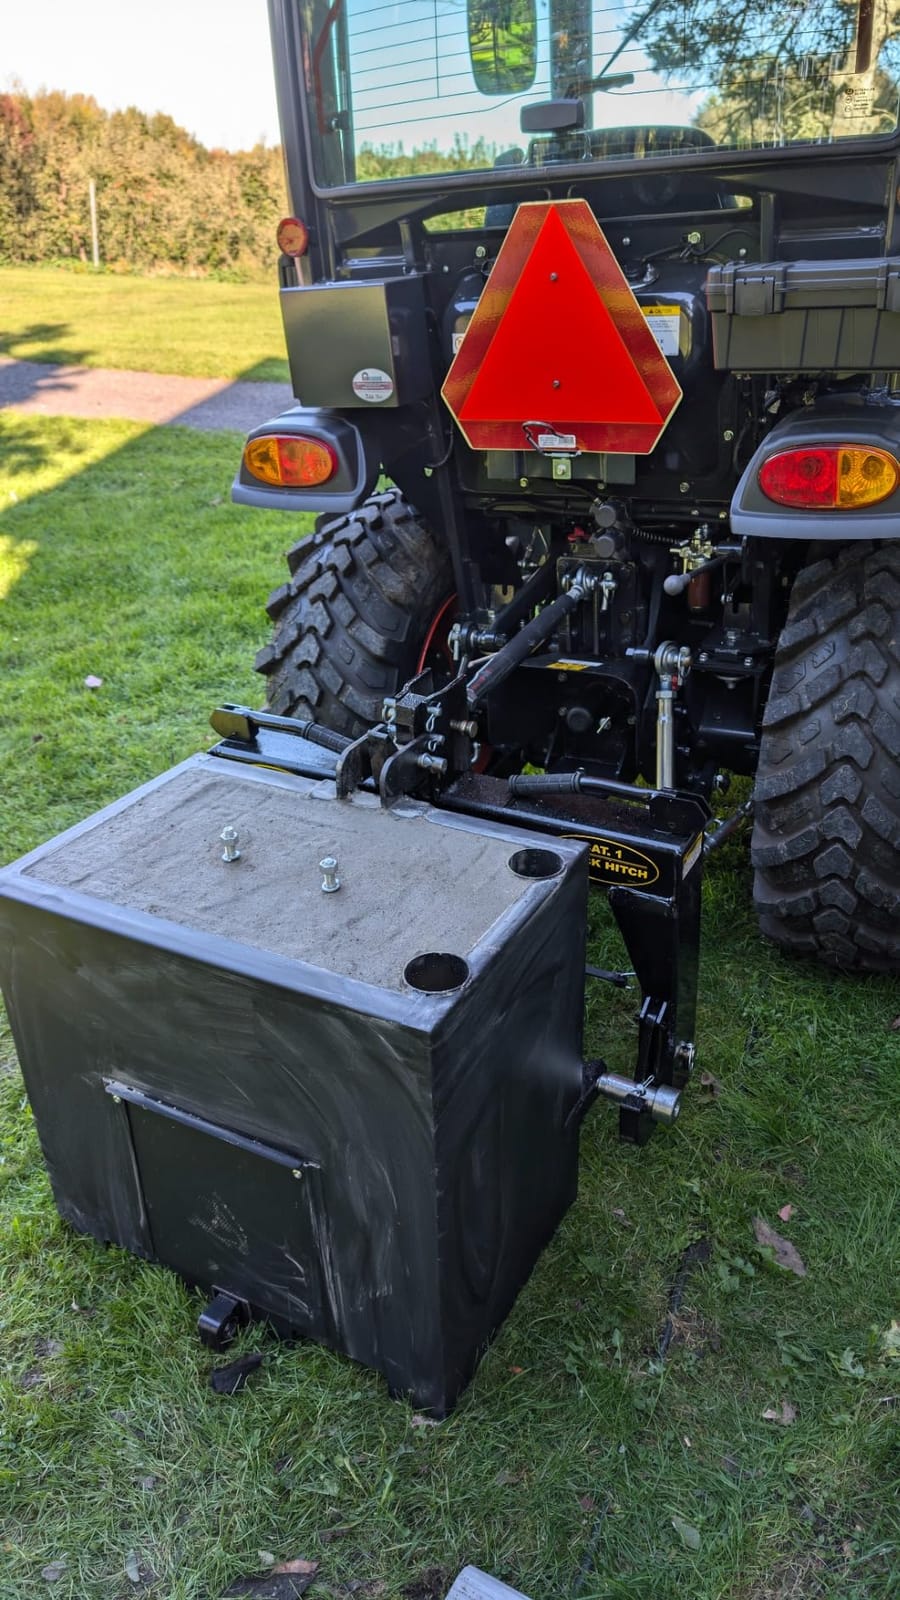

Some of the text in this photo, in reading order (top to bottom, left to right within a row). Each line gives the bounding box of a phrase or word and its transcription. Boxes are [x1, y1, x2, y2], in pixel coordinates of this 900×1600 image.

[590, 844, 622, 859] AT. 1
[605, 862, 648, 879] HITCH
